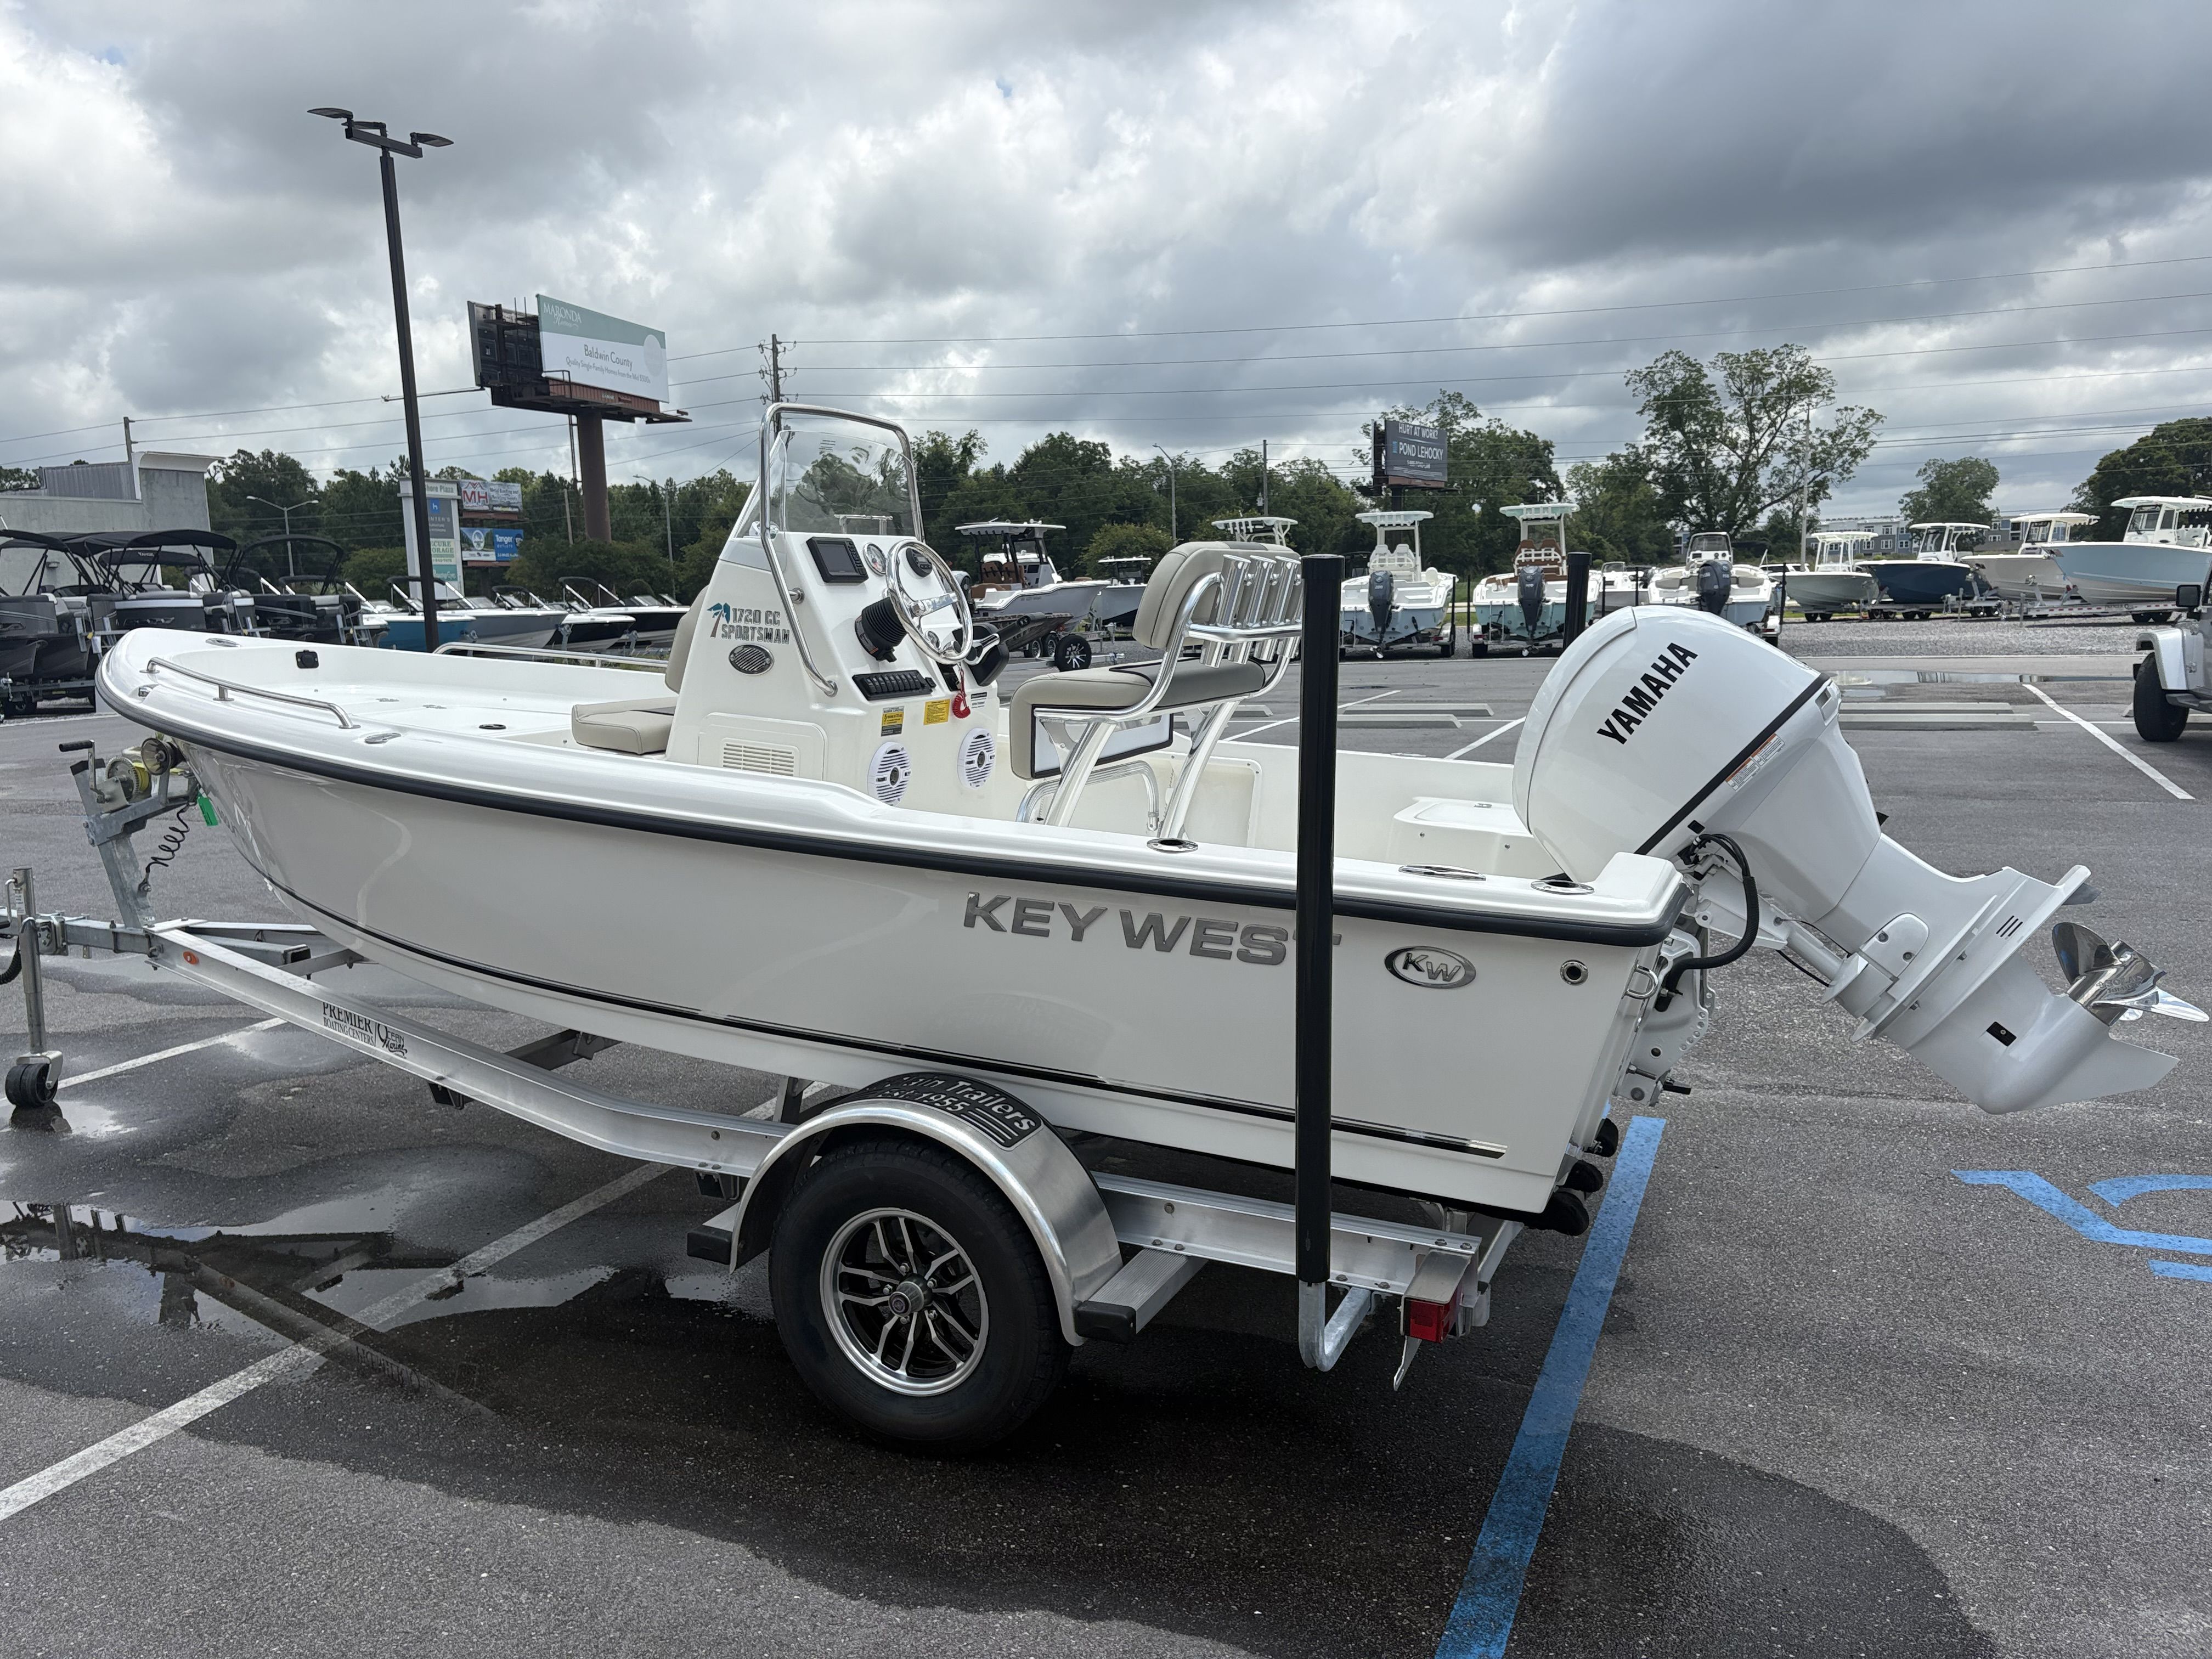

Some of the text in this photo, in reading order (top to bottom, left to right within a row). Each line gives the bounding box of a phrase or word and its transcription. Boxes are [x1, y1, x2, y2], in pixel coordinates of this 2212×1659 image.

[544, 303, 582, 323] MARONDA
[566, 357, 580, 369] Quality
[605, 368, 617, 376] Homes
[584, 345, 633, 371] Baldwin County
[1398, 422, 1438, 439] HURT AT WORK?
[1399, 442, 1443, 460] POND LEHOCKY
[462, 490, 488, 504] MH
[495, 534, 513, 544] Tanger
[732, 608, 781, 627] 1720 CC
[721, 624, 790, 645] SPORTSMAN
[1596, 642, 1698, 745] YAMAHA
[963, 891, 1342, 966] KEY WES
[1403, 953, 1462, 982] KW
[323, 1001, 373, 1035] PREMIER
[323, 1017, 374, 1046] BOATING CENTERS
[382, 1039, 407, 1053] Marine
[915, 1092, 970, 1112] 1955
[946, 1080, 1036, 1131] Trailers
